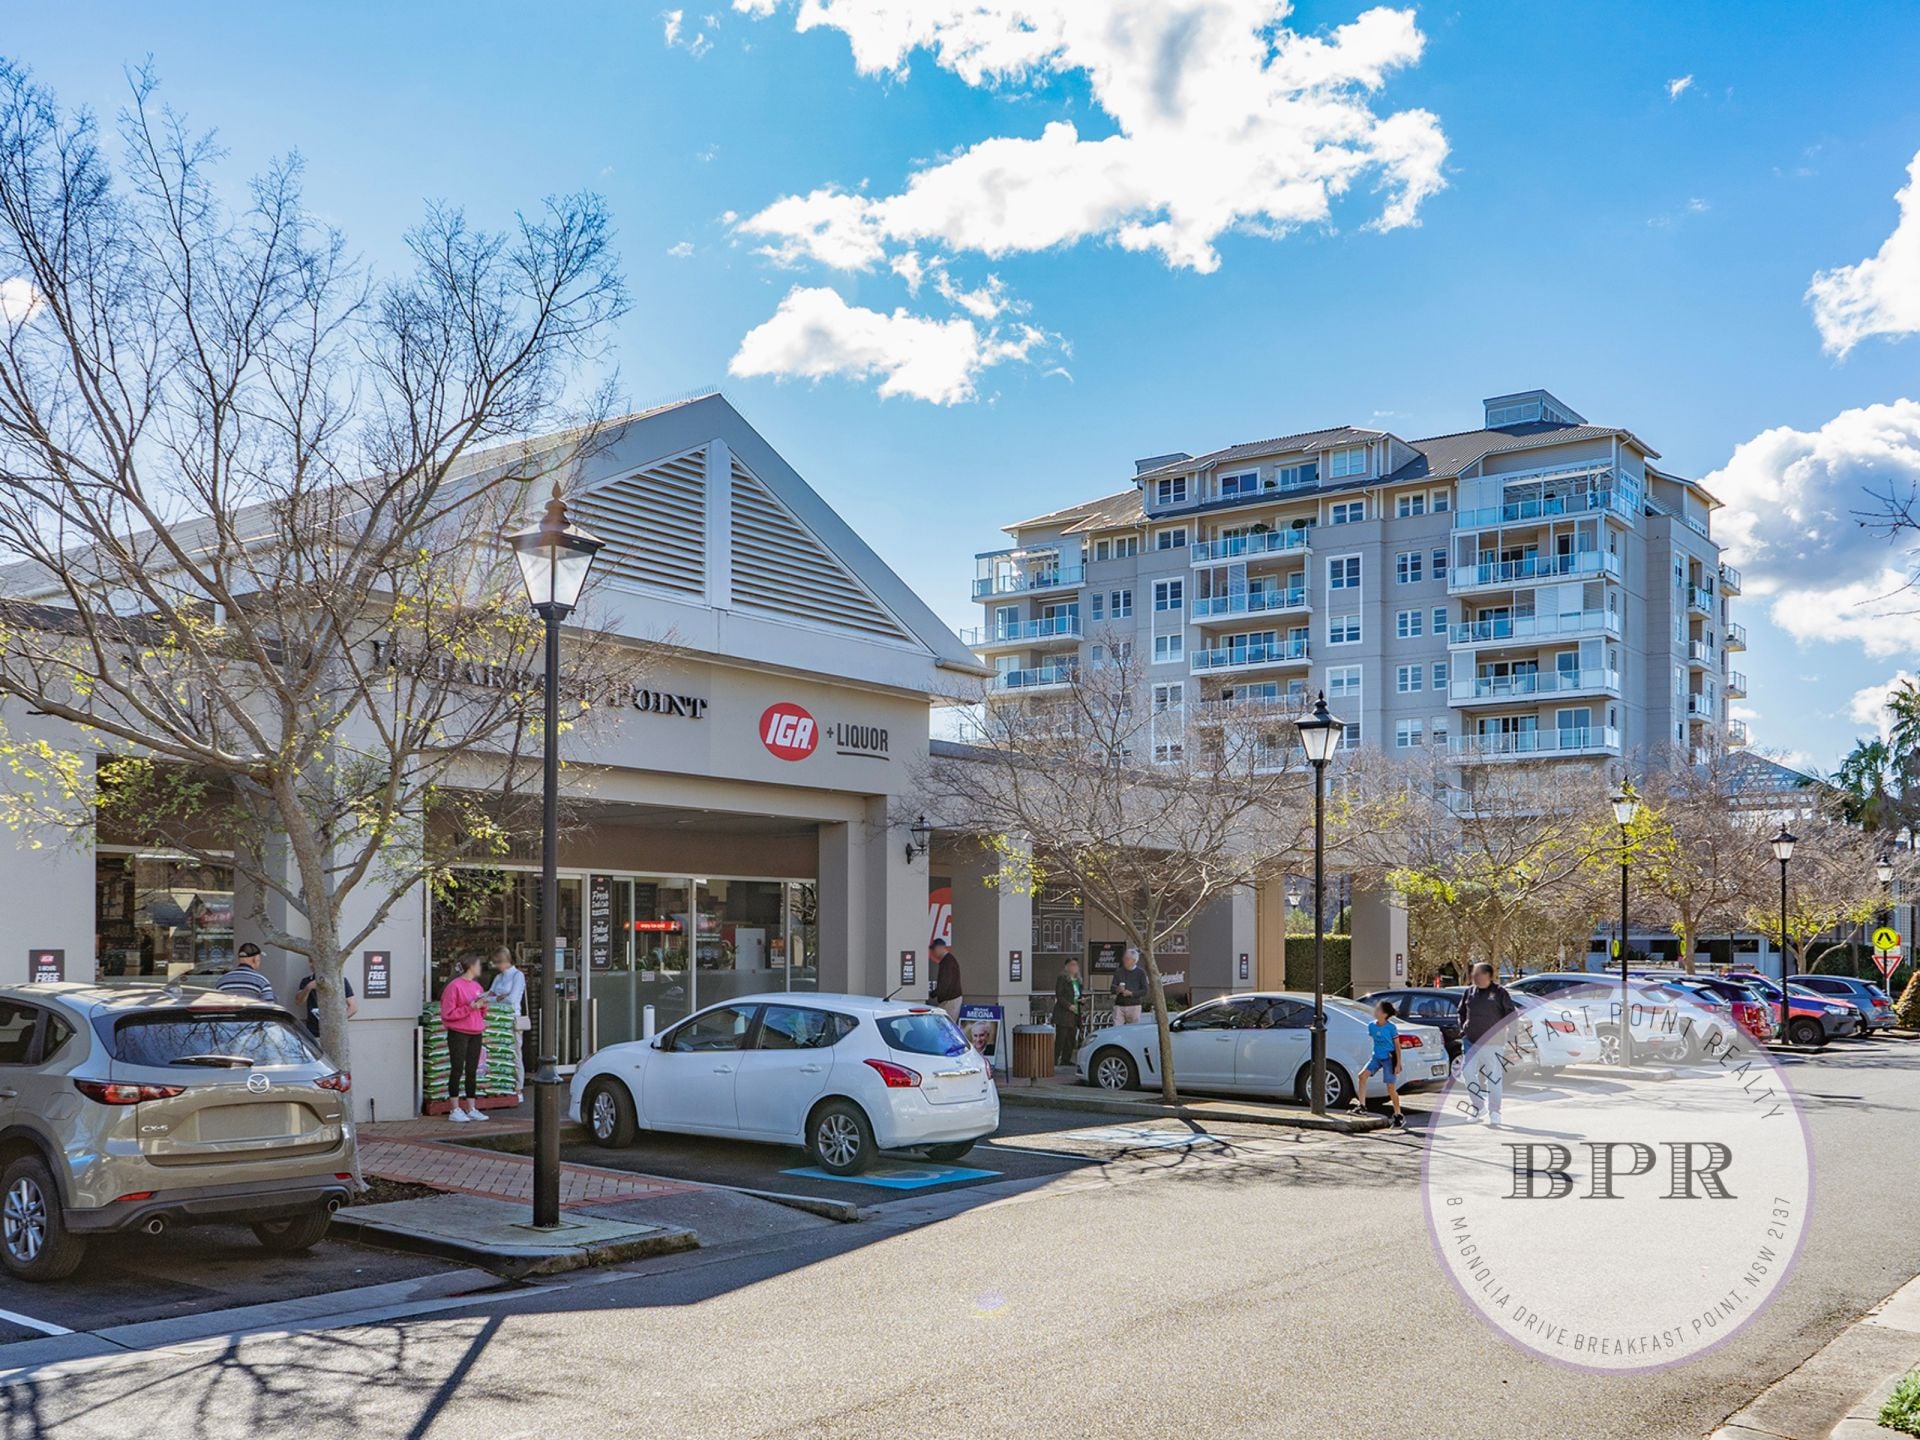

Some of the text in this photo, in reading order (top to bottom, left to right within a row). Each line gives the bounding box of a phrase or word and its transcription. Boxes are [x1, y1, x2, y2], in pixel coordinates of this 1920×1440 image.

[765, 713, 814, 750] IGA
[837, 723, 888, 752] LIQUOR
[35, 972, 60, 983] FREE
[368, 971, 387, 980] FREE
[141, 1124, 169, 1132] CX-5
